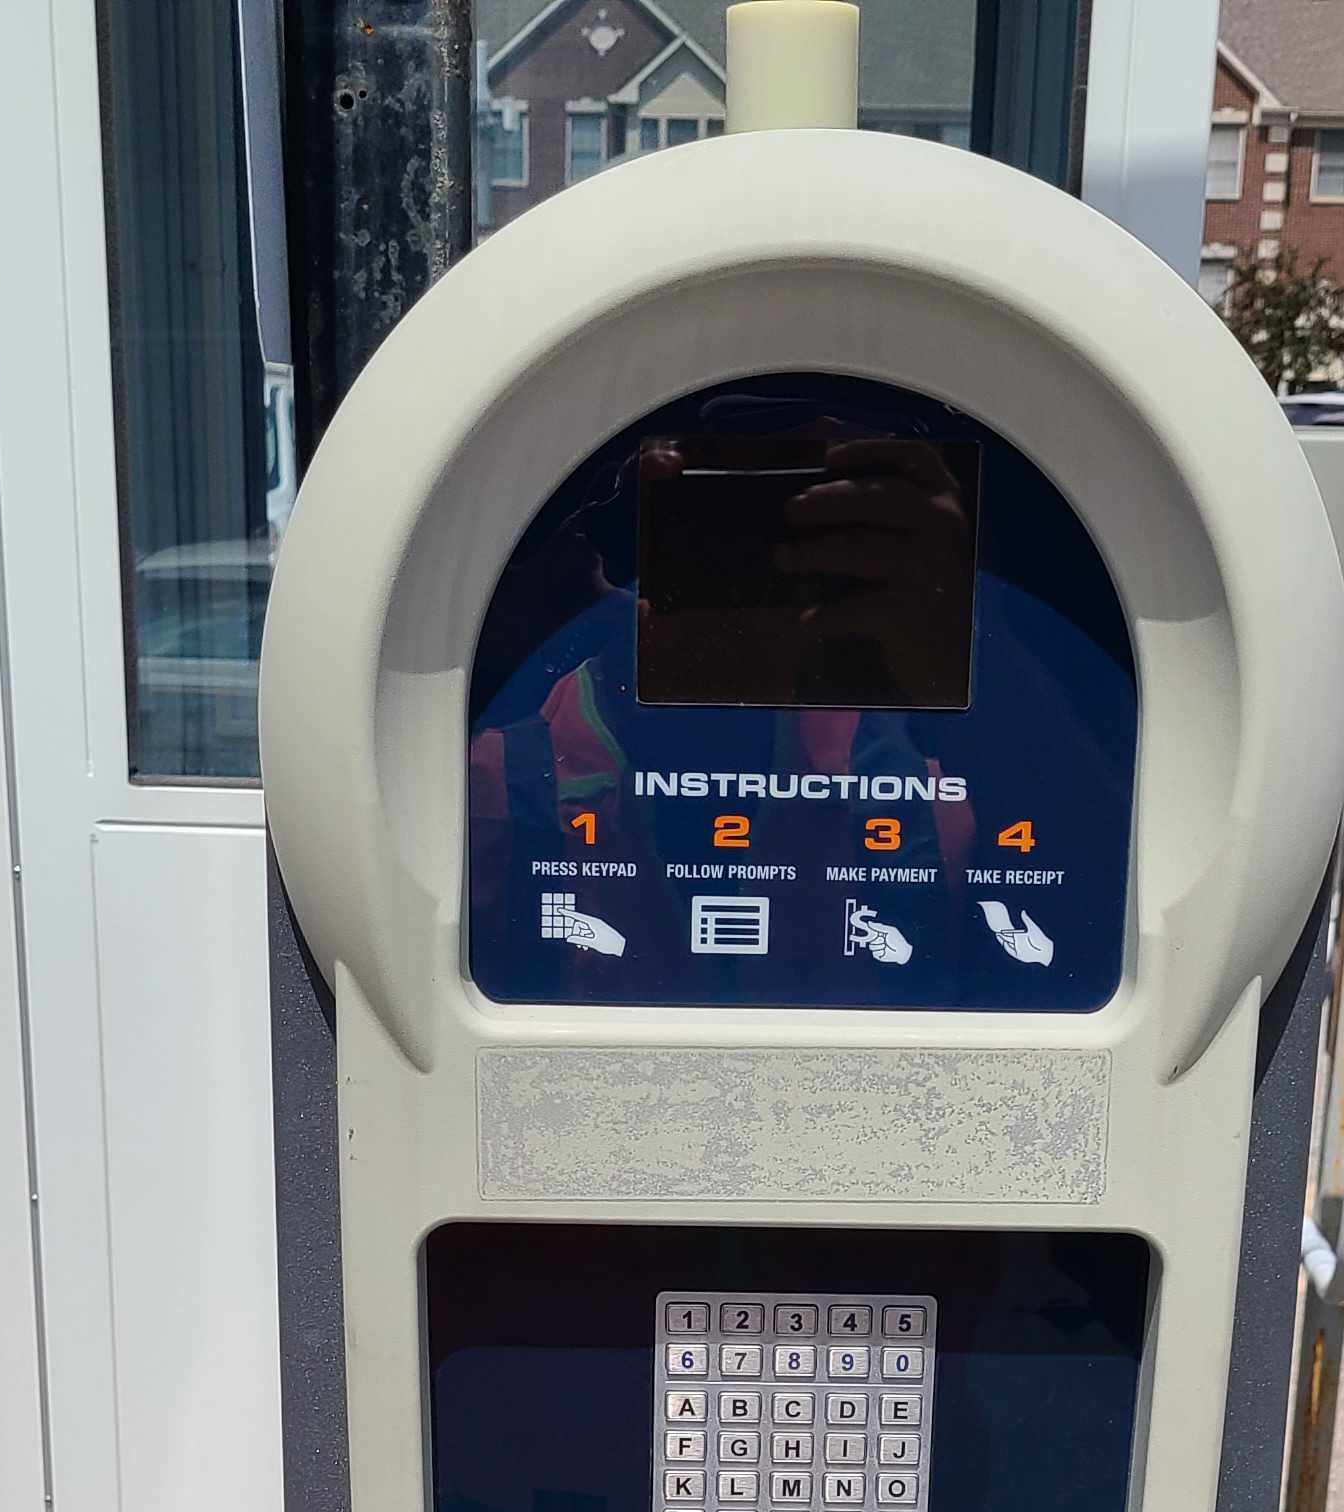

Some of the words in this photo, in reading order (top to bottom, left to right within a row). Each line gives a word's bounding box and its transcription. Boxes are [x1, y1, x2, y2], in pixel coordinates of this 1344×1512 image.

[634, 770, 968, 802] INSTRUCTIONS
[570, 812, 598, 845] 1
[712, 815, 751, 848] 2
[863, 818, 902, 851] 3
[996, 821, 1036, 853] 4
[532, 861, 578, 876] PRESS
[582, 862, 637, 877] KEYPAD
[666, 863, 724, 879] FOLLOW
[728, 865, 797, 880] PROMPTS
[825, 867, 867, 882] MAKE
[871, 868, 938, 883] PAYMENT
[965, 869, 1002, 884] TAKE
[1005, 870, 1065, 885] RECEIPT
[682, 1310, 692, 1330] 1
[735, 1310, 750, 1330] 2
[789, 1313, 803, 1332] 3
[842, 1312, 858, 1332] 4
[898, 1313, 912, 1333] 5
[681, 1350, 694, 1369] 6
[734, 1352, 747, 1370] 7
[788, 1352, 801, 1370] 8
[841, 1353, 854, 1372] 9
[678, 1398, 696, 1417] A
[732, 1399, 748, 1417] B
[785, 1400, 801, 1418] C
[839, 1400, 856, 1419] D
[893, 1401, 909, 1420] E
[678, 1437, 693, 1456] F
[730, 1439, 748, 1457] G
[784, 1439, 801, 1458] H
[892, 1441, 906, 1459] J
[675, 1477, 692, 1496] K
[730, 1477, 744, 1496] L
[782, 1479, 802, 1497] M
[836, 1479, 852, 1497] N
